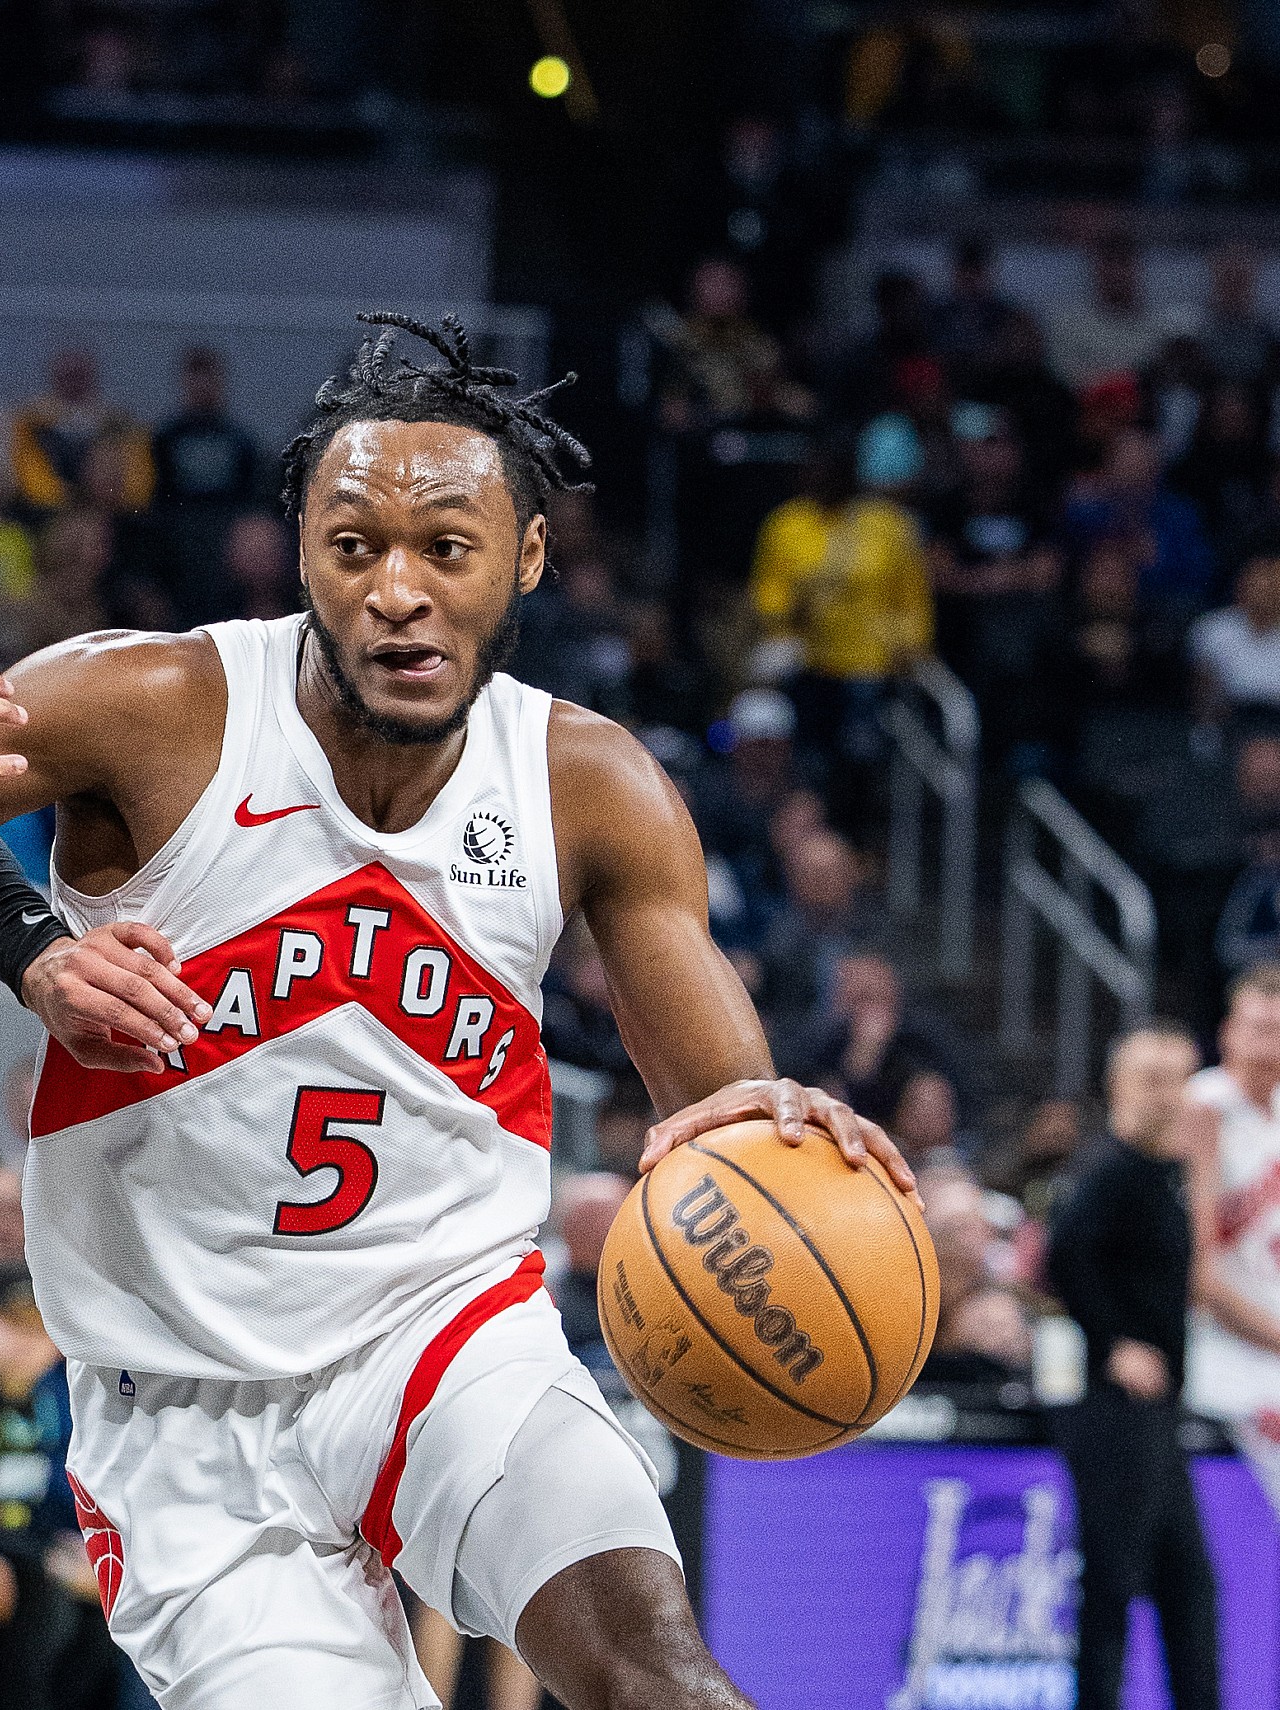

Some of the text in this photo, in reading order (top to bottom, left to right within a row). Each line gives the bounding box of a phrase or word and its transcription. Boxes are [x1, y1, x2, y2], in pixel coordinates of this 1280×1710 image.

[449, 863, 527, 888] Sun Life
[272, 1085, 386, 1237] 5
[671, 1173, 824, 1386] Wilson
